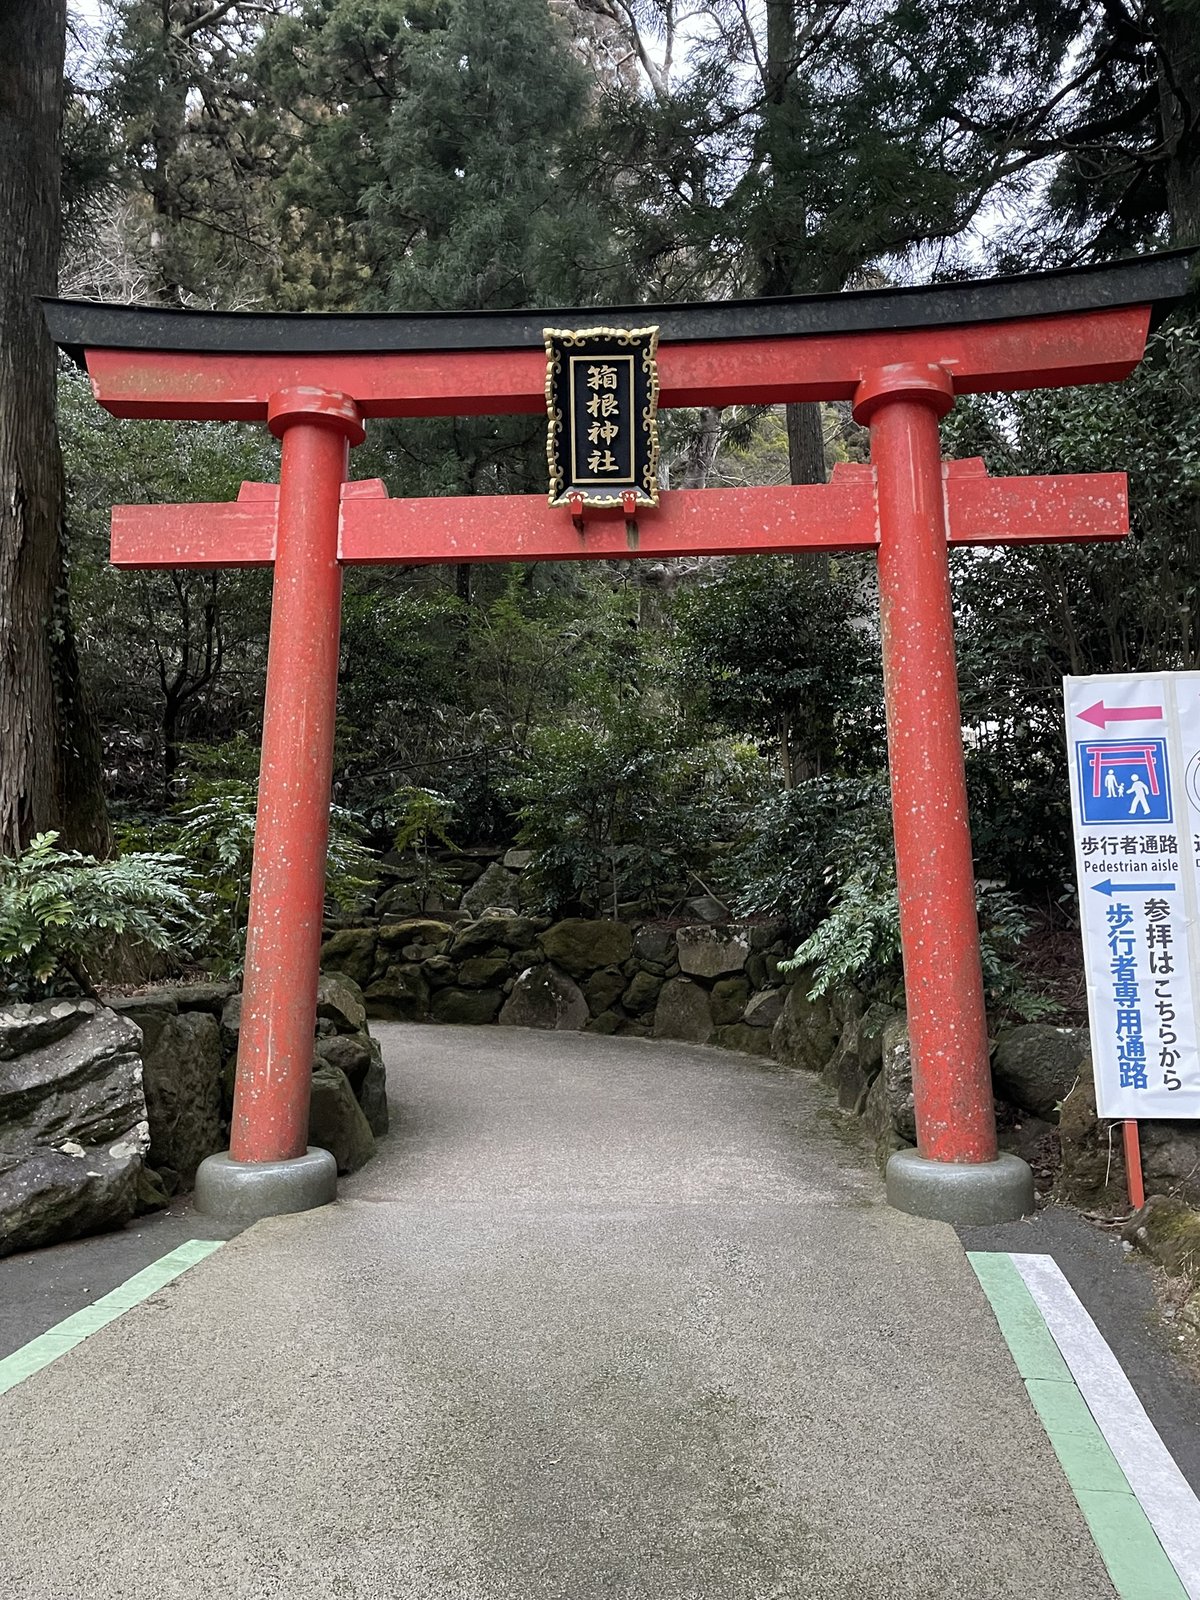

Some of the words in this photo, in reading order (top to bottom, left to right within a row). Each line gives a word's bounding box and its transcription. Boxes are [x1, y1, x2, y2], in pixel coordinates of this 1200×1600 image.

[586, 365, 619, 473] 箱根神社
[1081, 834, 1178, 855] 歩行者通路
[1084, 859, 1148, 873] Pedestrian
[1151, 858, 1178, 871] aisle
[1106, 903, 1148, 1089] 歩行者専用通路
[1144, 898, 1182, 1091] 参拝はこちらから
